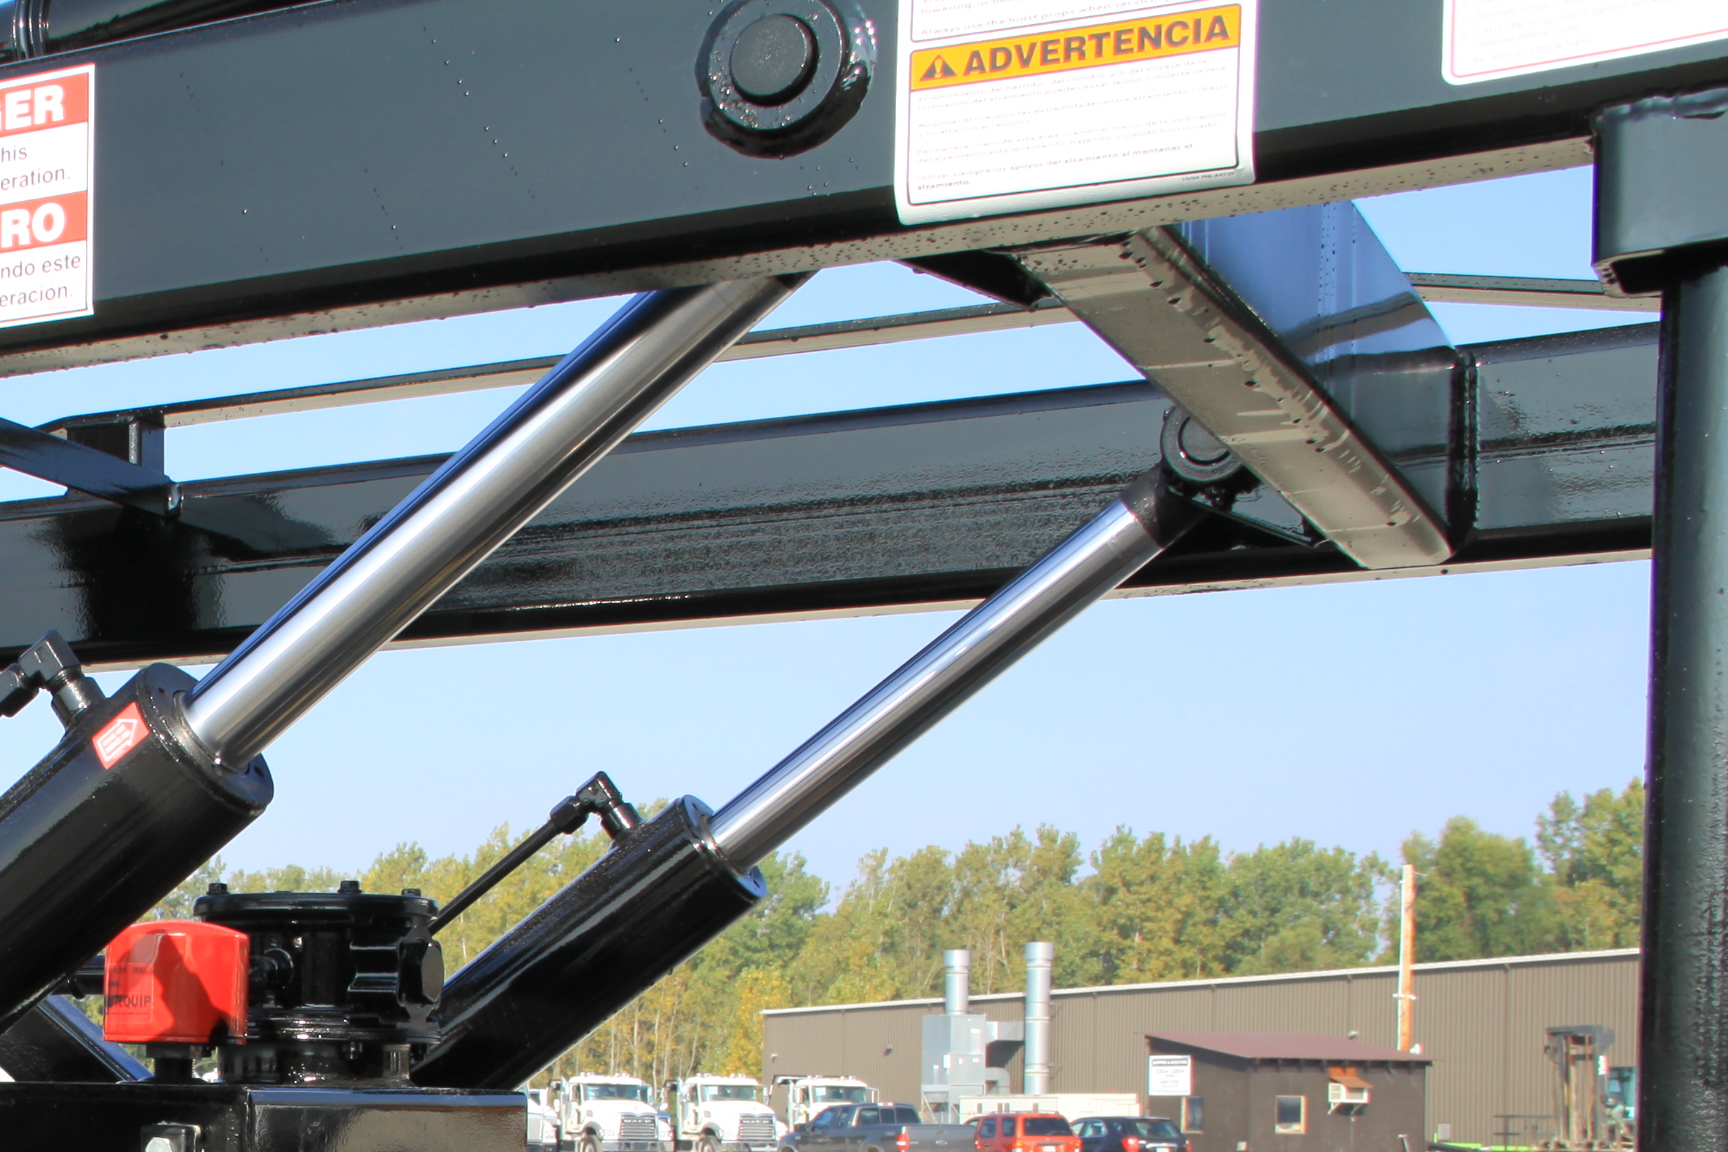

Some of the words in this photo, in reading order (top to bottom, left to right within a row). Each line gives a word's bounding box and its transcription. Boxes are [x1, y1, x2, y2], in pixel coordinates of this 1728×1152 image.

[921, 23, 961, 35] Always
[964, 22, 983, 30] use
[986, 19, 1005, 27] the
[1008, 14, 1037, 24] hoist
[1041, 9, 1074, 20] props
[1079, 3, 1110, 13] when
[963, 15, 1229, 75] ADVERTENCIA
[41, 252, 80, 273] este
